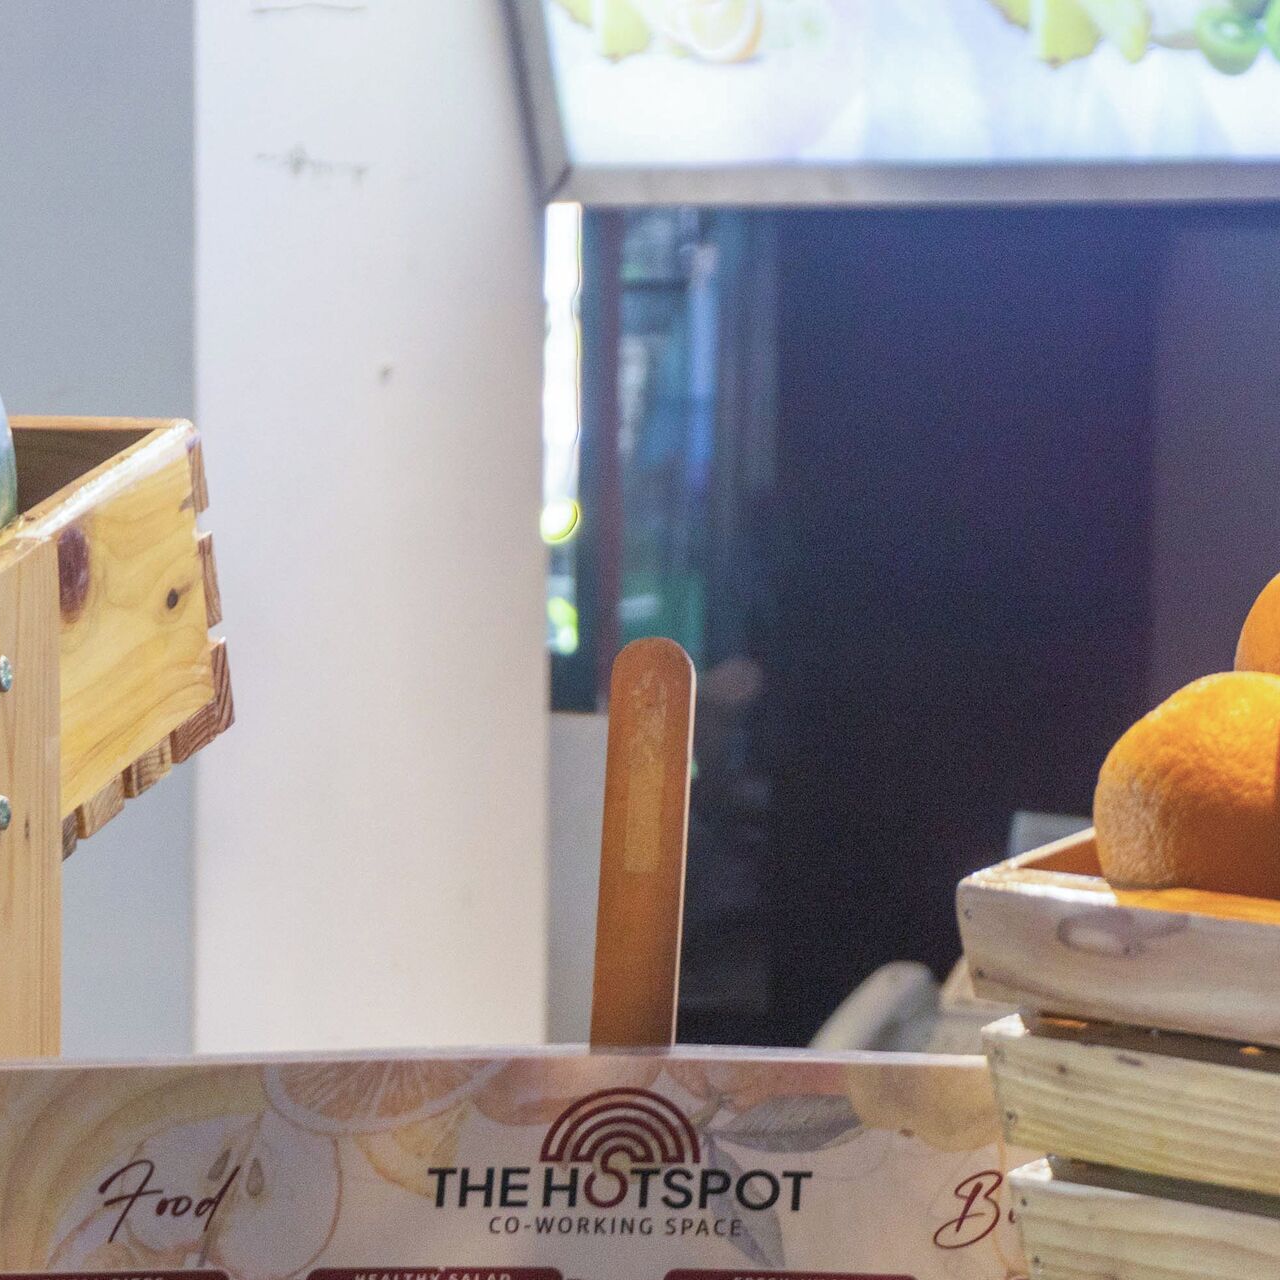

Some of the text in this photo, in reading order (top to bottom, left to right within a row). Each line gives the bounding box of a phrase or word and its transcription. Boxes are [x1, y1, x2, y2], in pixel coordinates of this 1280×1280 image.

[97, 1158, 242, 1241] Food
[427, 1155, 812, 1212] THE HOTSPOT
[488, 1217, 743, 1237] CO-WORKING SPACE
